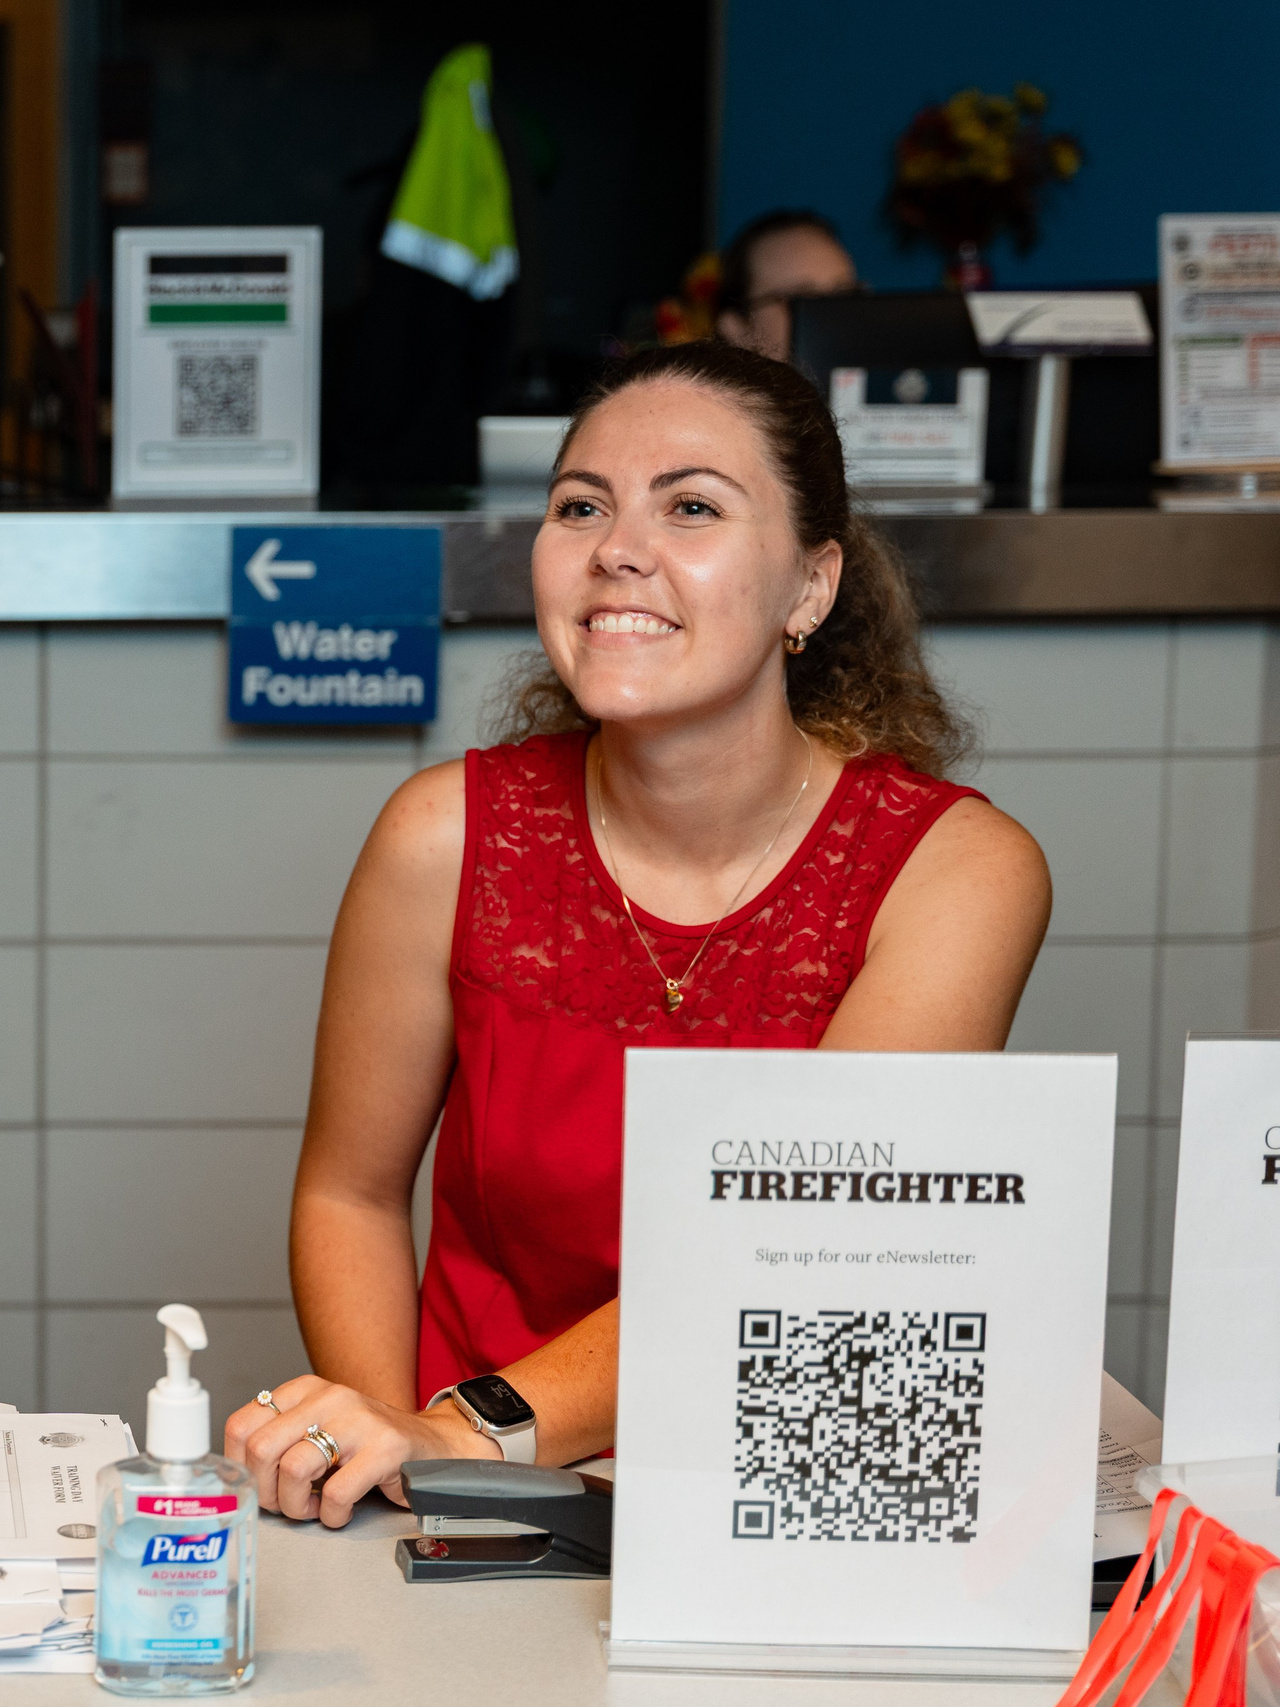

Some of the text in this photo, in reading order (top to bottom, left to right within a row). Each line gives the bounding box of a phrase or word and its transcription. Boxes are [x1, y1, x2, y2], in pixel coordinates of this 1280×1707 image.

[273, 620, 398, 662] Water
[241, 665, 424, 707] Fountain
[711, 1140, 895, 1168] CANADIAN
[710, 1169, 1025, 1204] FIREFIGHTER
[755, 1248, 976, 1266] Sign up for our eNewsletter:
[71, 1490, 83, 1503] DAY
[153, 1499, 173, 1516] #1
[151, 1536, 223, 1561] Purell
[151, 1570, 218, 1580] ADVANCED
